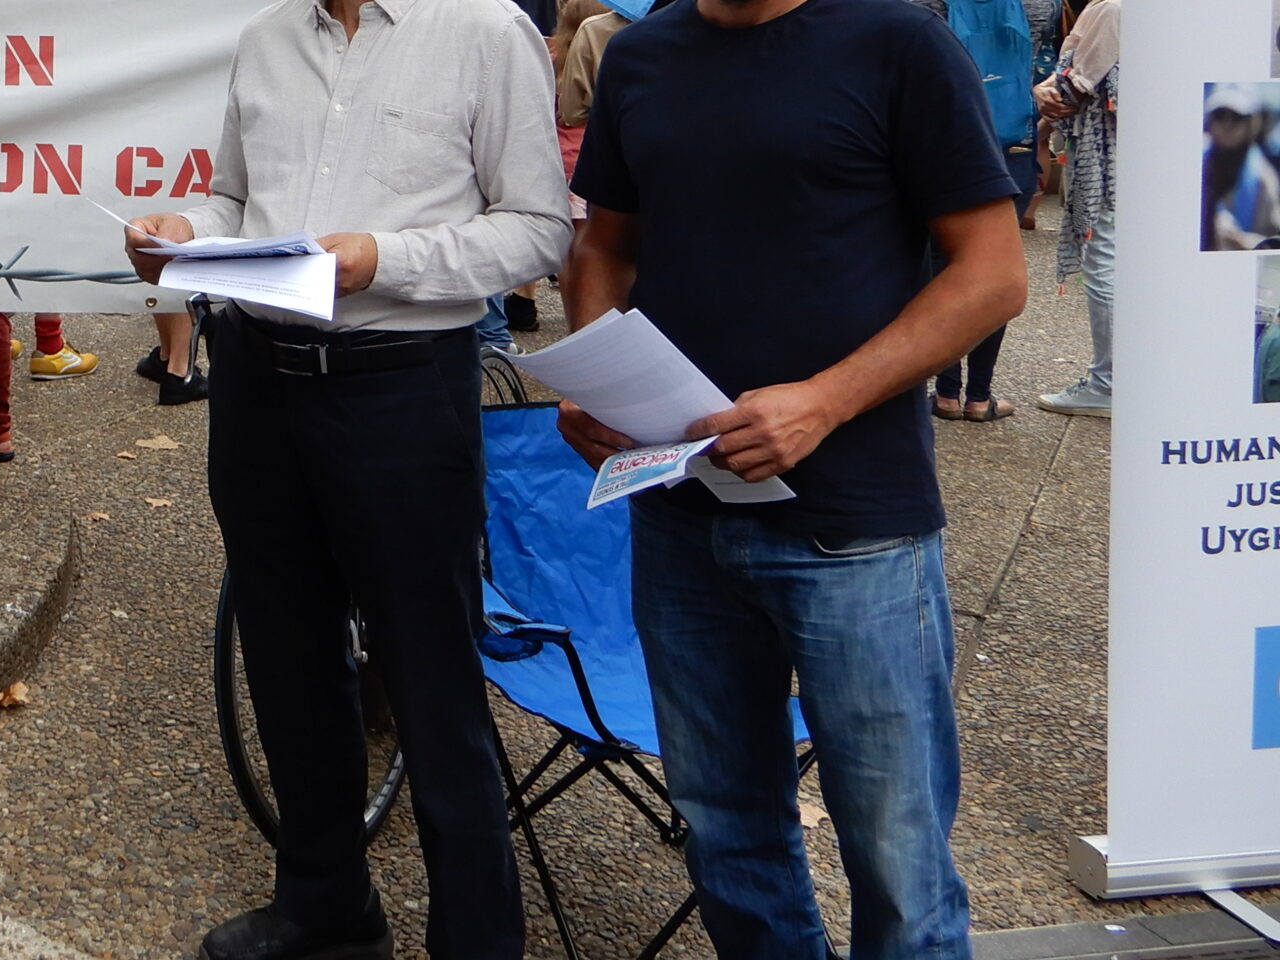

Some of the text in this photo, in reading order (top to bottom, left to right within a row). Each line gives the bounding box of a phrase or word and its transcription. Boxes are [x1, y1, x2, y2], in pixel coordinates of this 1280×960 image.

[116, 146, 214, 199] CA
[610, 451, 680, 474] welcome
[1201, 525, 1280, 555] UYG
